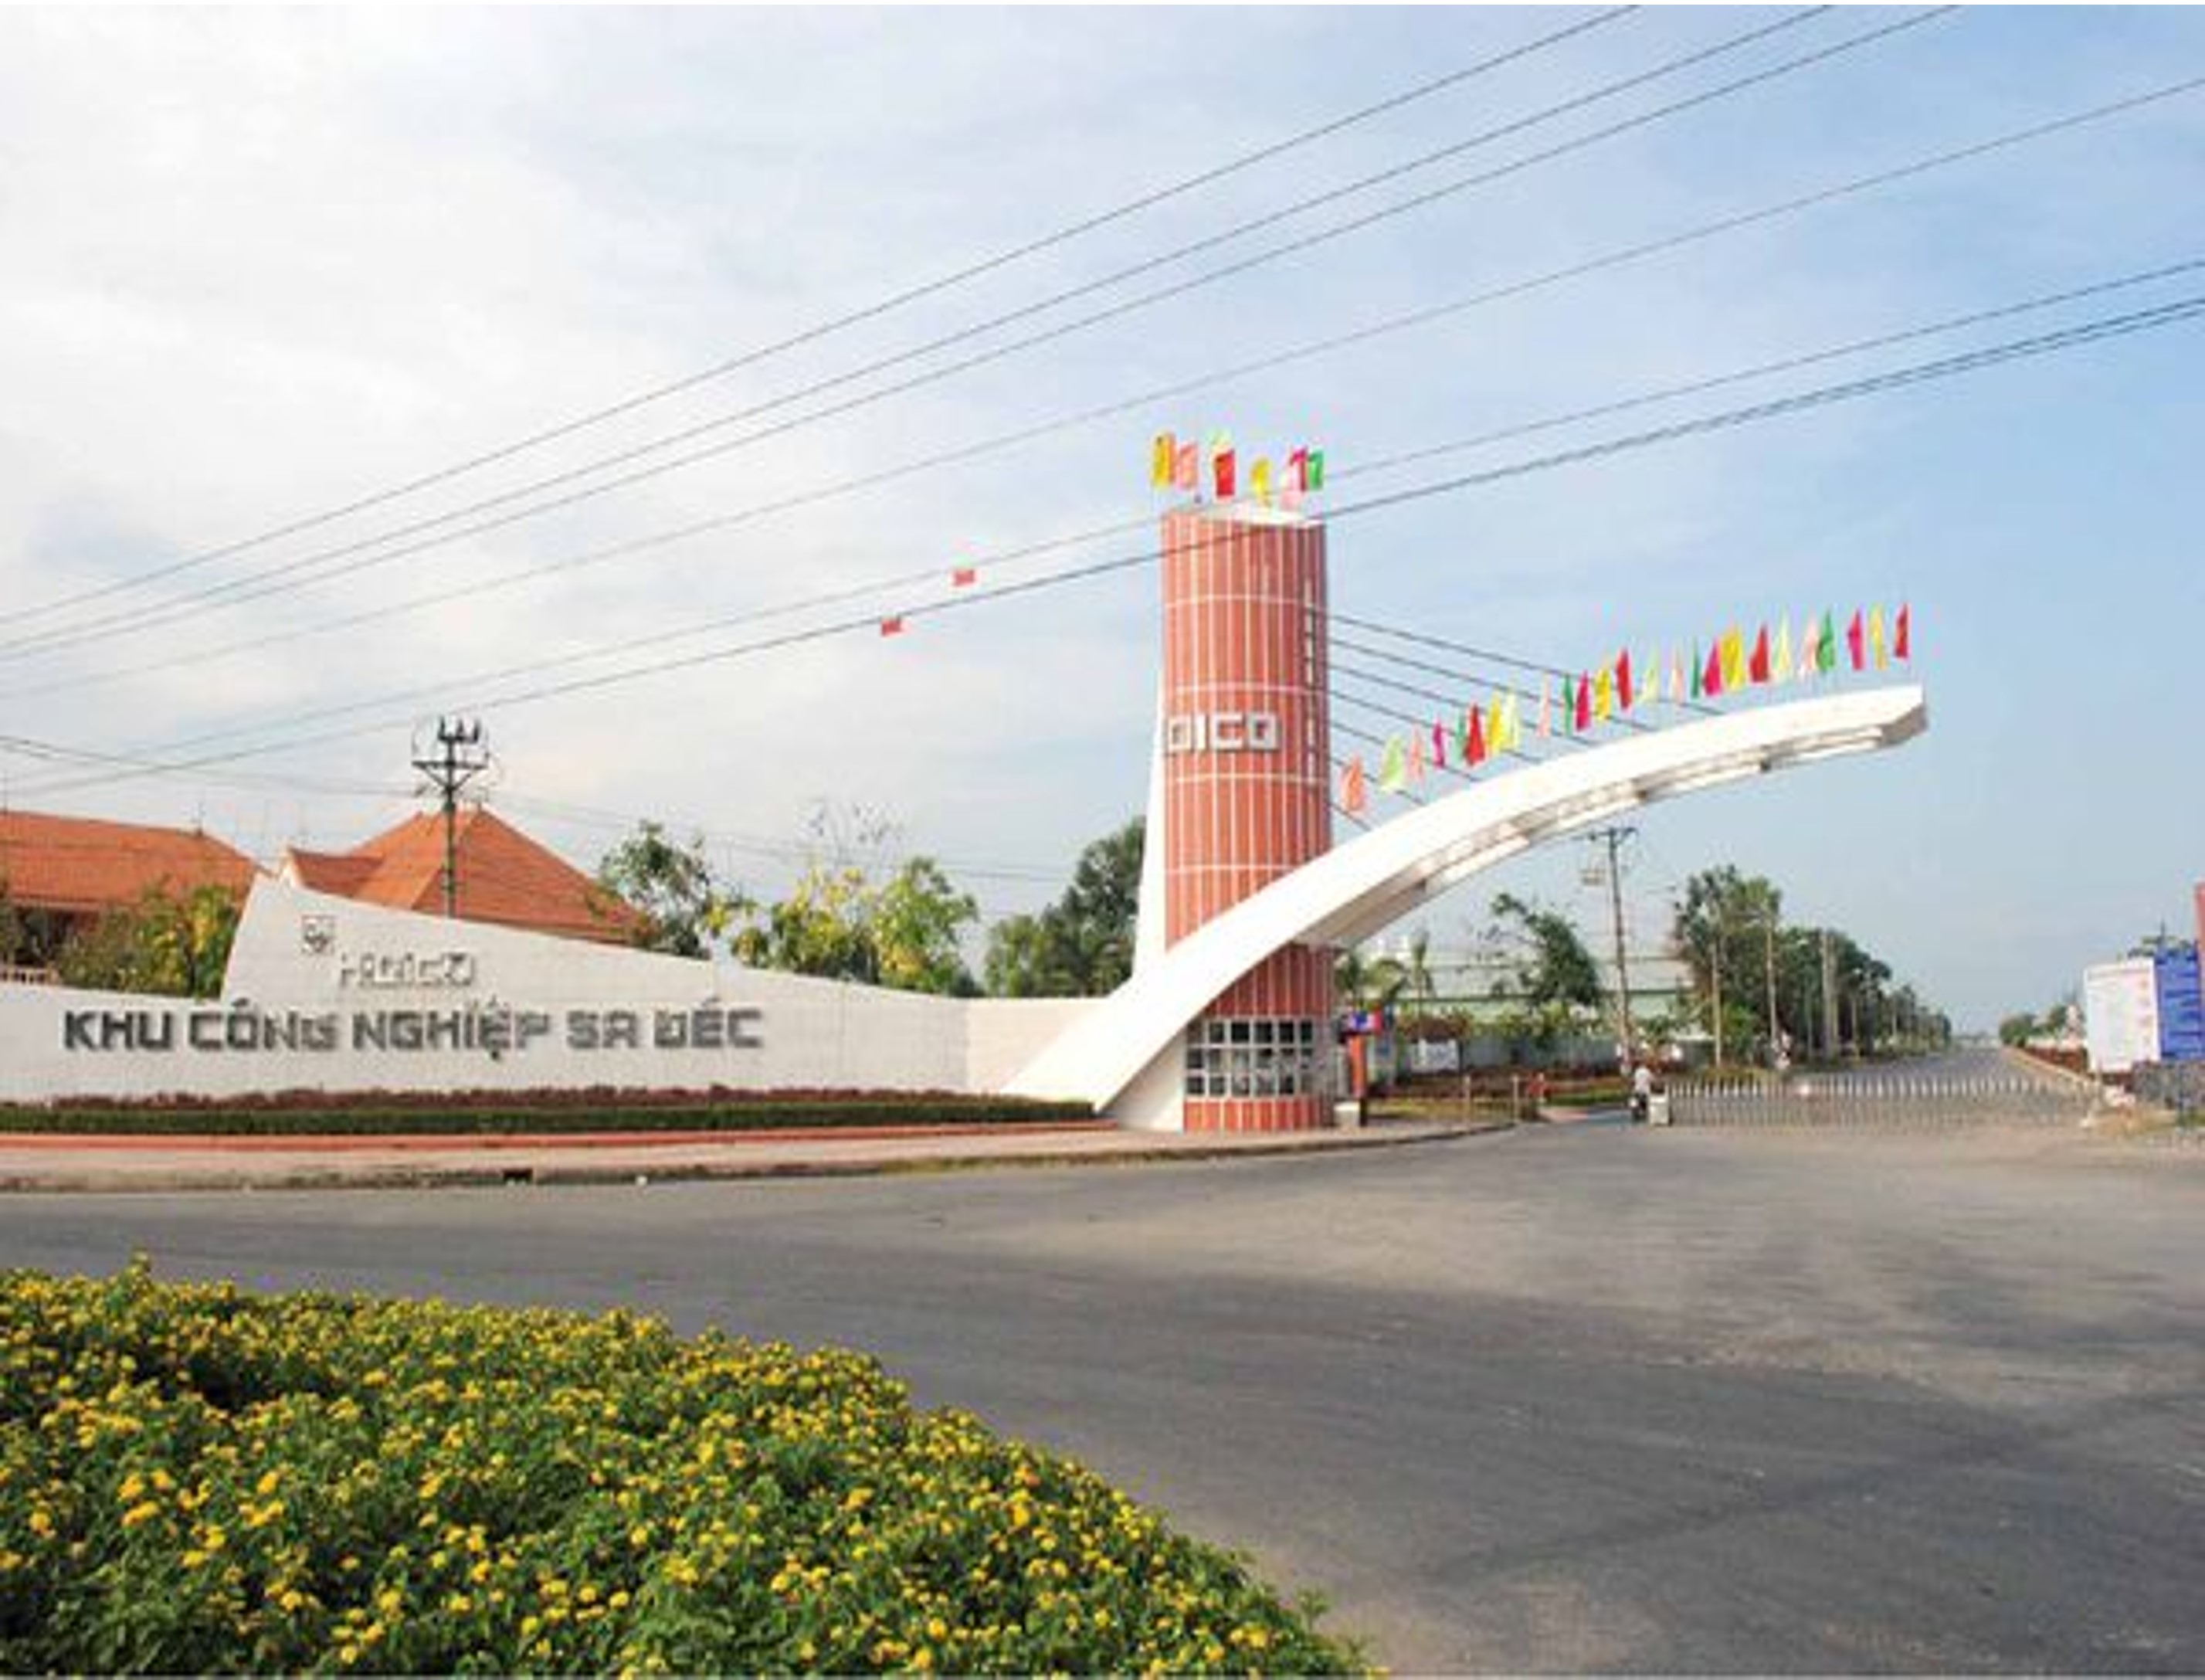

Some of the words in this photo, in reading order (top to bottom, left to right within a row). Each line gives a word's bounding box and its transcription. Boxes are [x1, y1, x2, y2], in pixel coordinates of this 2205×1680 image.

[64, 1010, 173, 1050] KHU
[188, 997, 338, 1051] CÔNG
[352, 995, 550, 1061] NGHIỆP
[566, 1010, 638, 1049] SA
